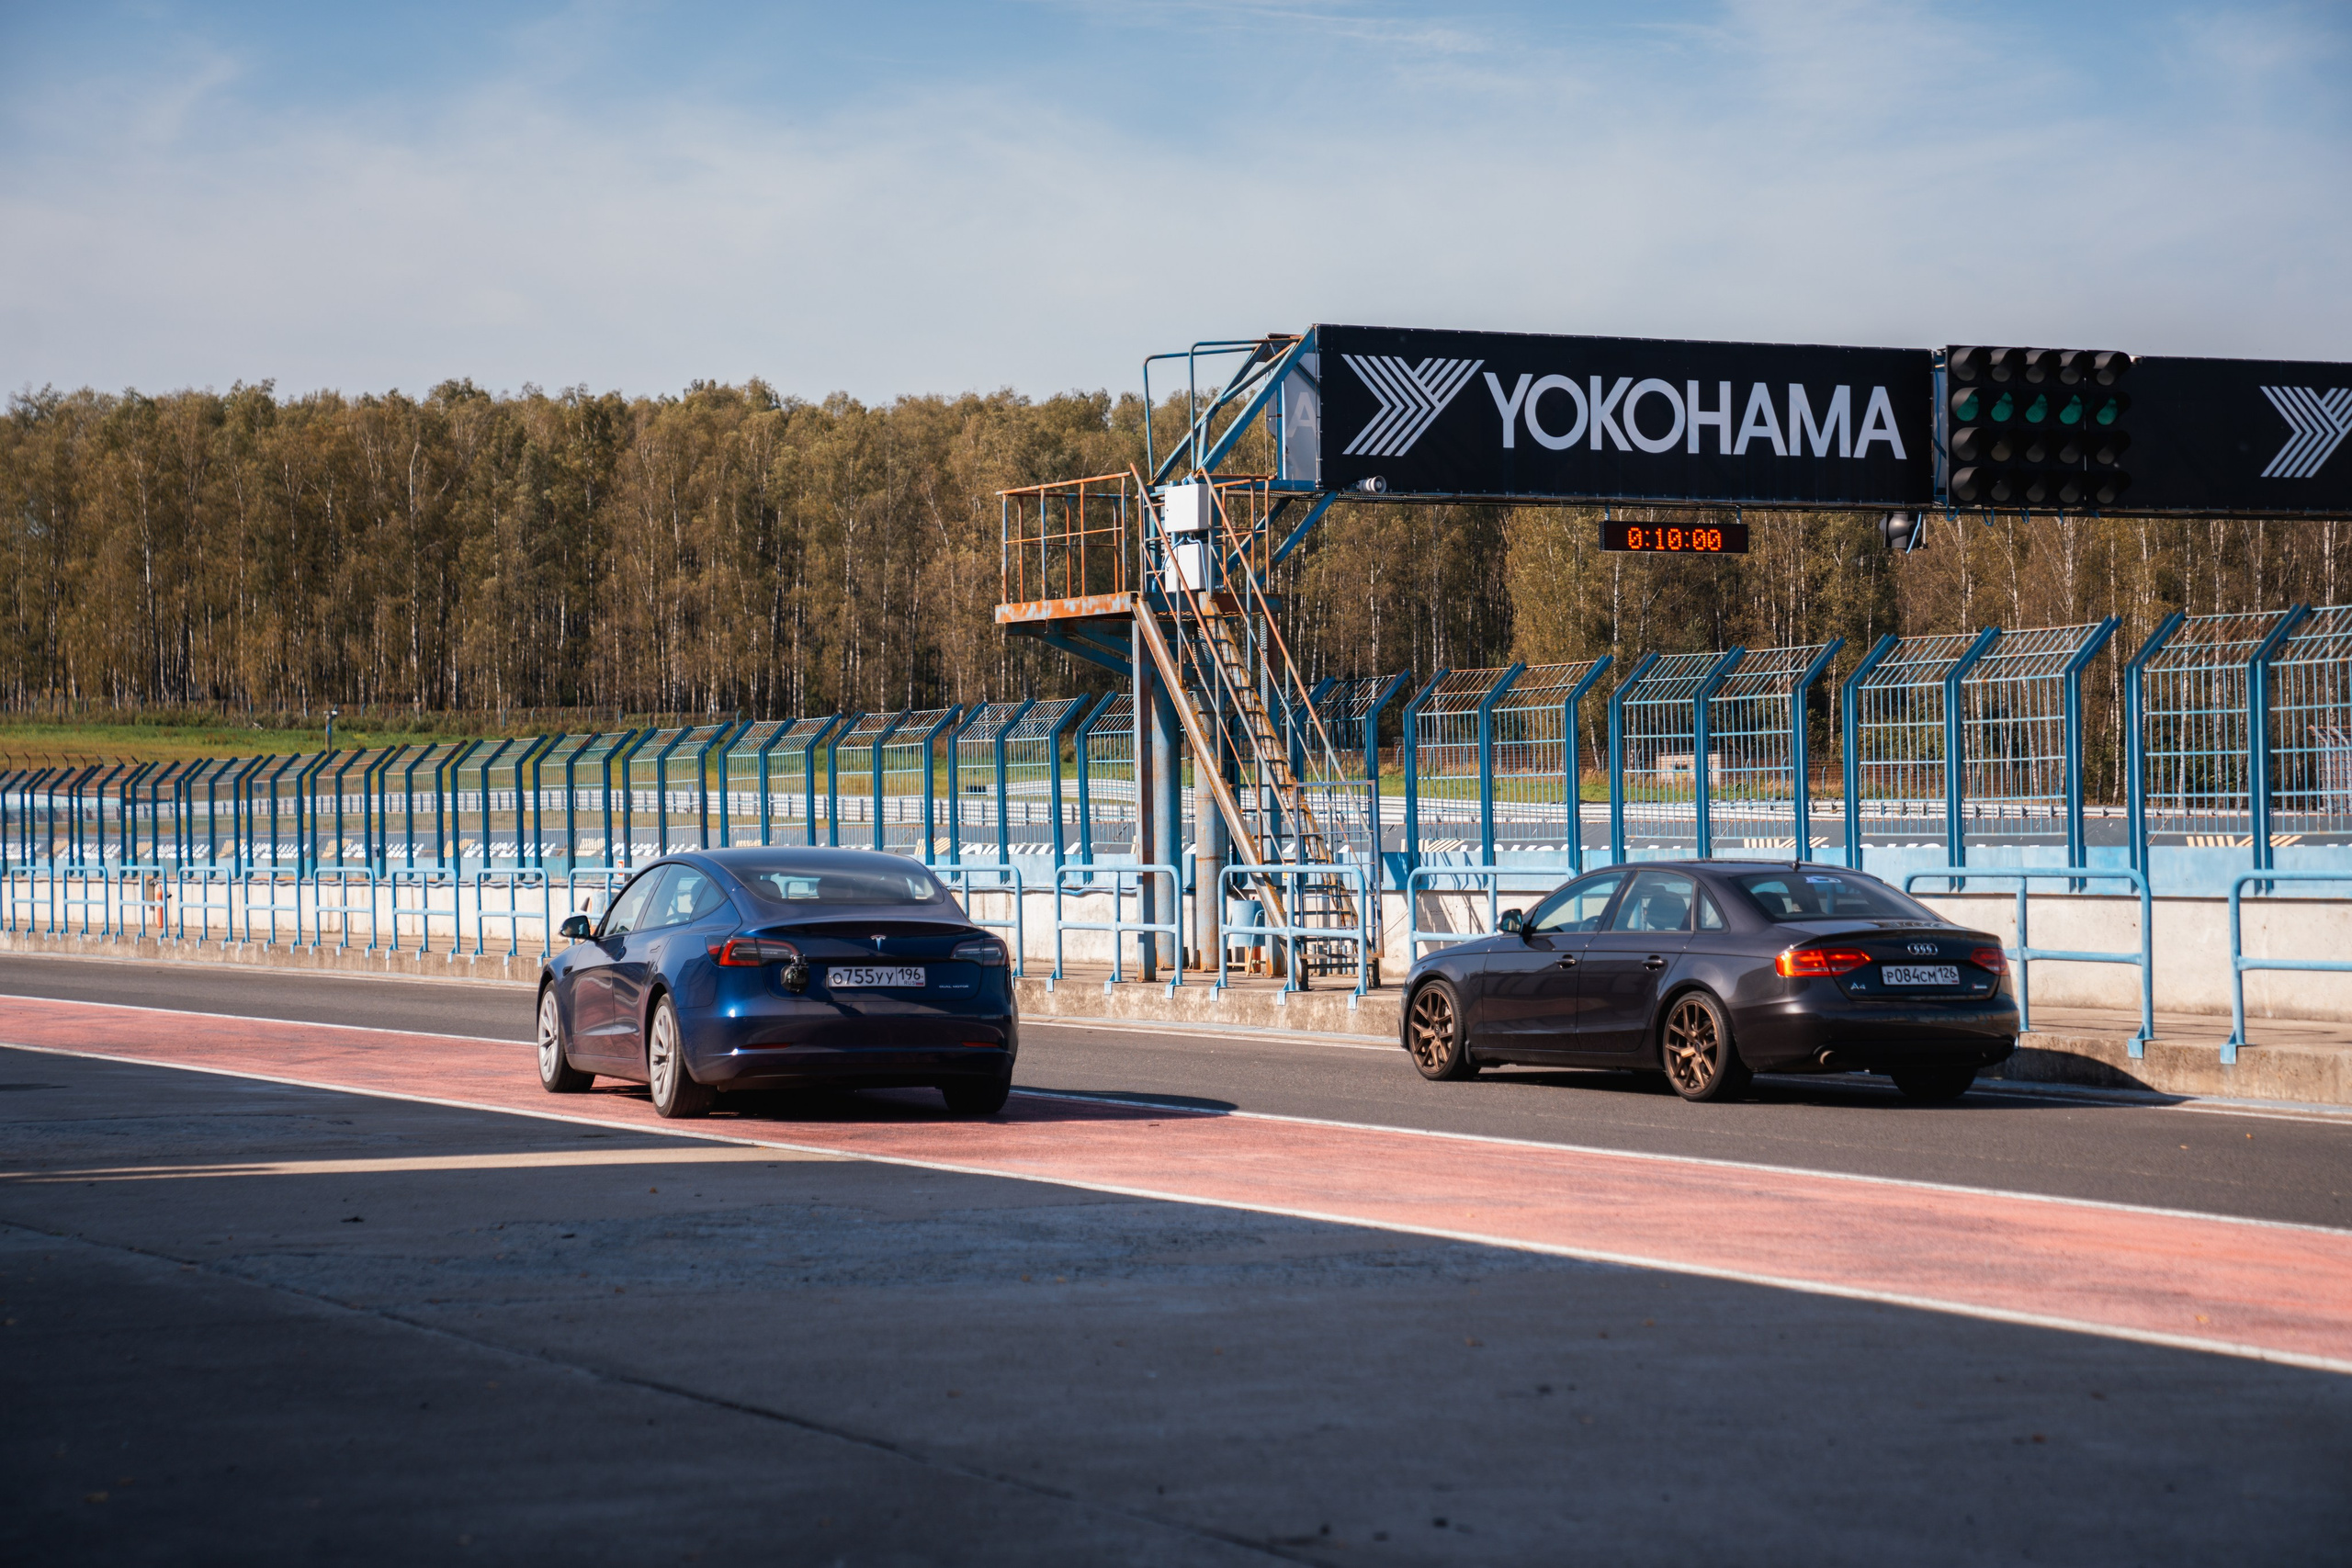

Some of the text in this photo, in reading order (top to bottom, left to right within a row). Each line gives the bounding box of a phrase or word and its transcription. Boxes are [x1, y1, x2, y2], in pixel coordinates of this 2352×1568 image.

[1483, 372, 1907, 459] YOKOHAMA
[1628, 527, 1721, 550] 0:10:00
[898, 968, 922, 980] 196
[1938, 966, 1956, 979] 126
[1850, 982, 1866, 991] A4
